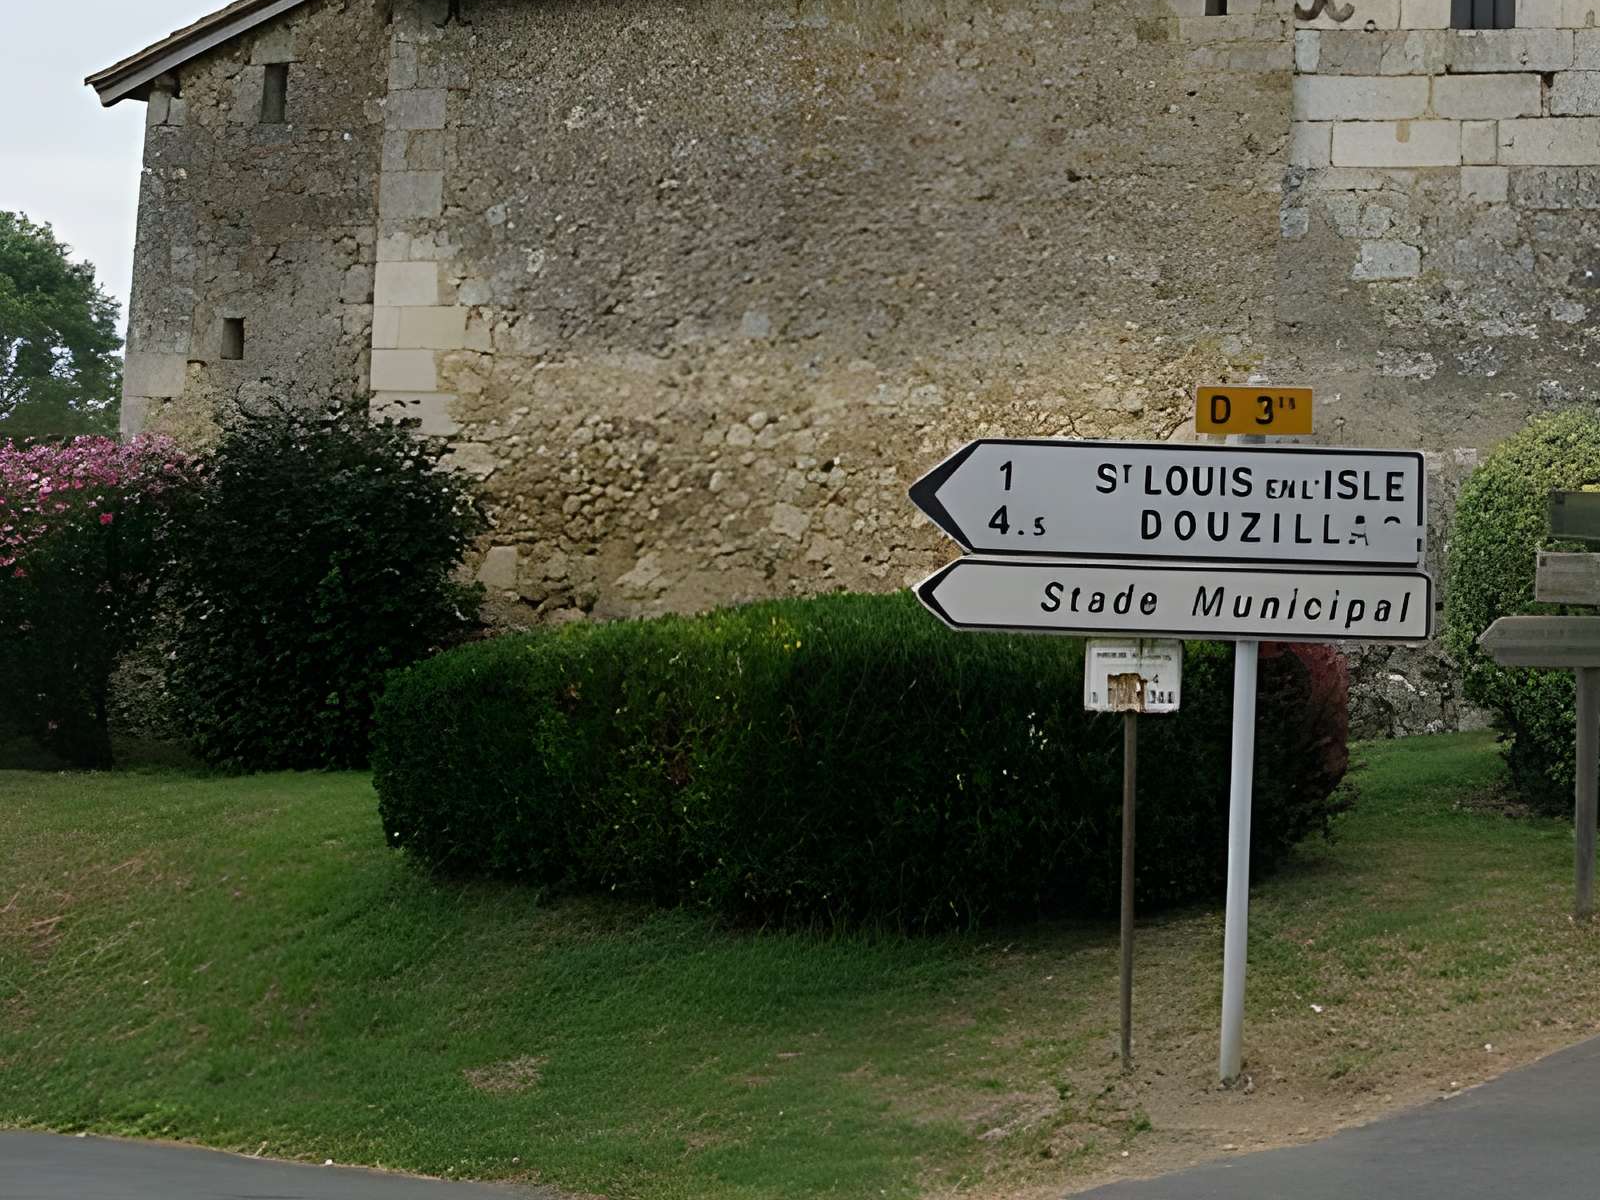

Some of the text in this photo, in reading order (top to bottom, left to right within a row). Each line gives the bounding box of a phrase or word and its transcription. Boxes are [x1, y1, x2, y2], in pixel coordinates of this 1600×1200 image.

[1211, 395, 1231, 424] D
[1000, 460, 1012, 491] 1
[1144, 465, 1253, 497] LOUIS
[1141, 509, 1401, 546] DOUZILLA
[1041, 581, 1411, 629] Stade Municipal
